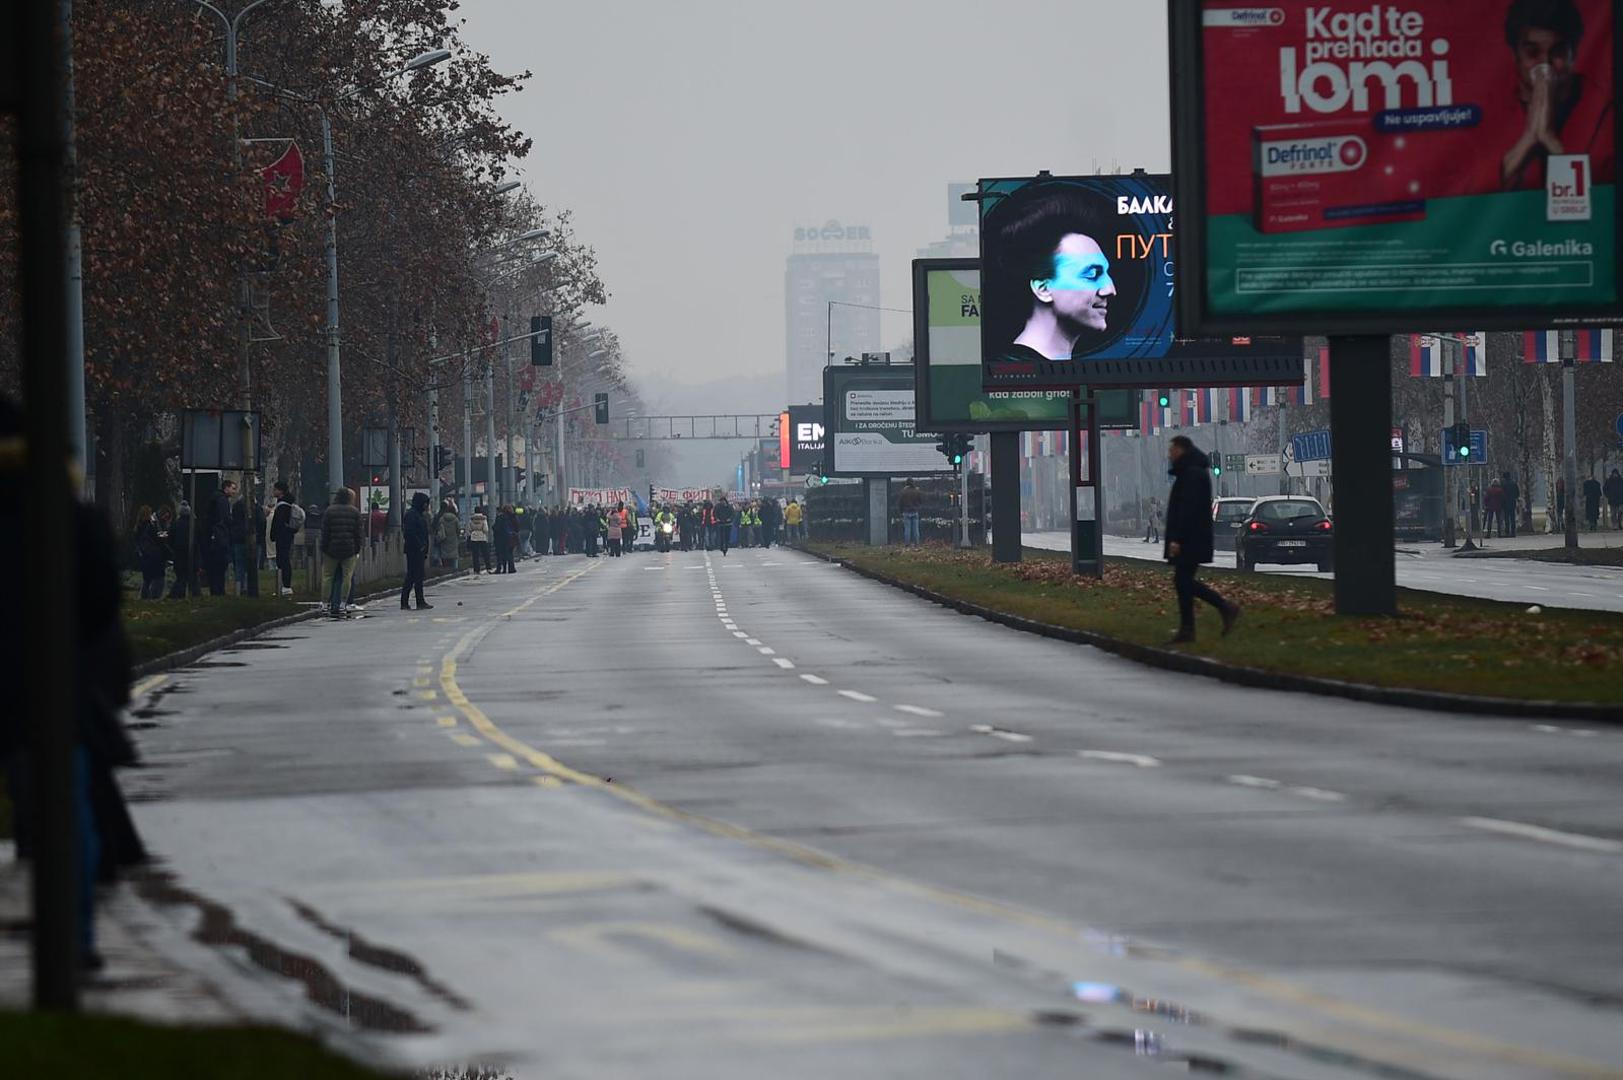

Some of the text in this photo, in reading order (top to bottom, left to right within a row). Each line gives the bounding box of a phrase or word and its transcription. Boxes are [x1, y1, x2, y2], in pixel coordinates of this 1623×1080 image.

[1306, 5, 1423, 38] Kad te
[1306, 36, 1422, 64] prehlada
[1280, 39, 1453, 113] lomi
[1268, 143, 1333, 164] Defrinol
[1512, 240, 1592, 256] Galenika
[961, 295, 975, 304] SA
[902, 430, 914, 438] TU
